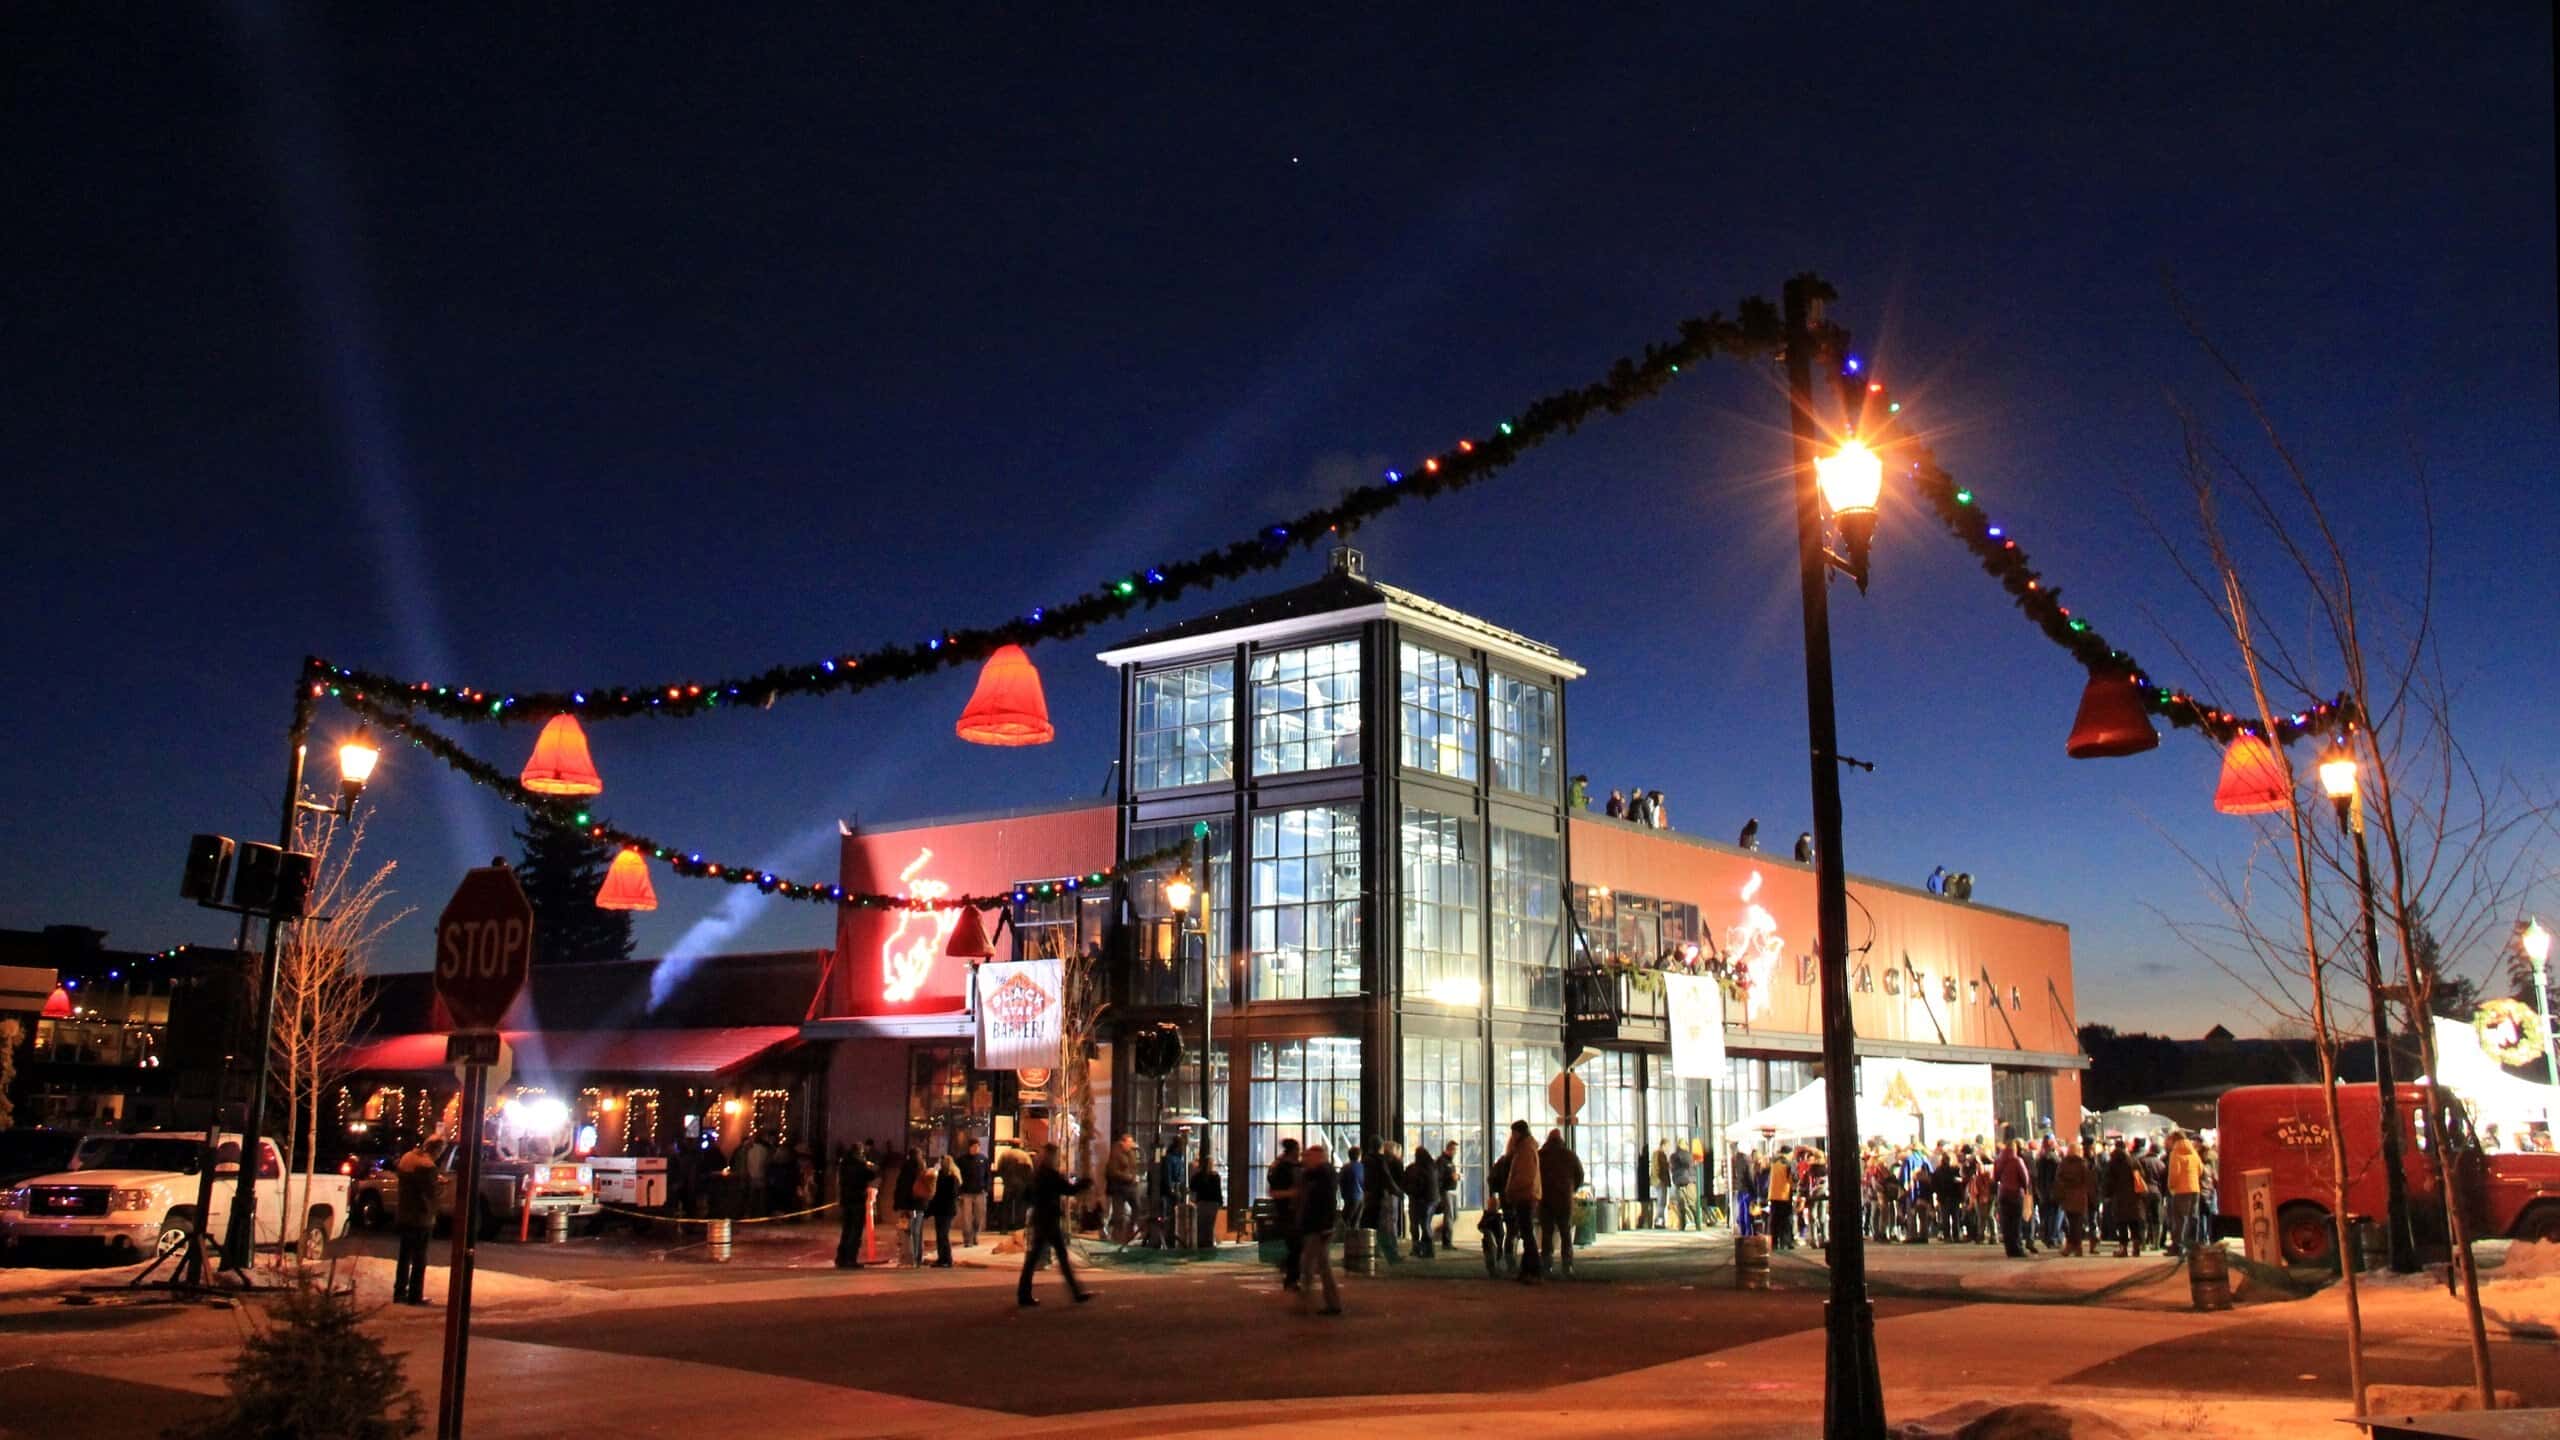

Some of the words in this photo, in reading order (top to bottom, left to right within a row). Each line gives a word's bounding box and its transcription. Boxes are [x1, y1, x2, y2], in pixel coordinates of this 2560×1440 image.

[442, 917, 525, 981] STOP
[1796, 954, 1926, 1000] BACK
[992, 986, 1044, 1008] BLACK
[1001, 1005, 1034, 1017] STAR
[2278, 1123, 2330, 1139] BLACK
[2287, 1135, 2323, 1145] STAR
